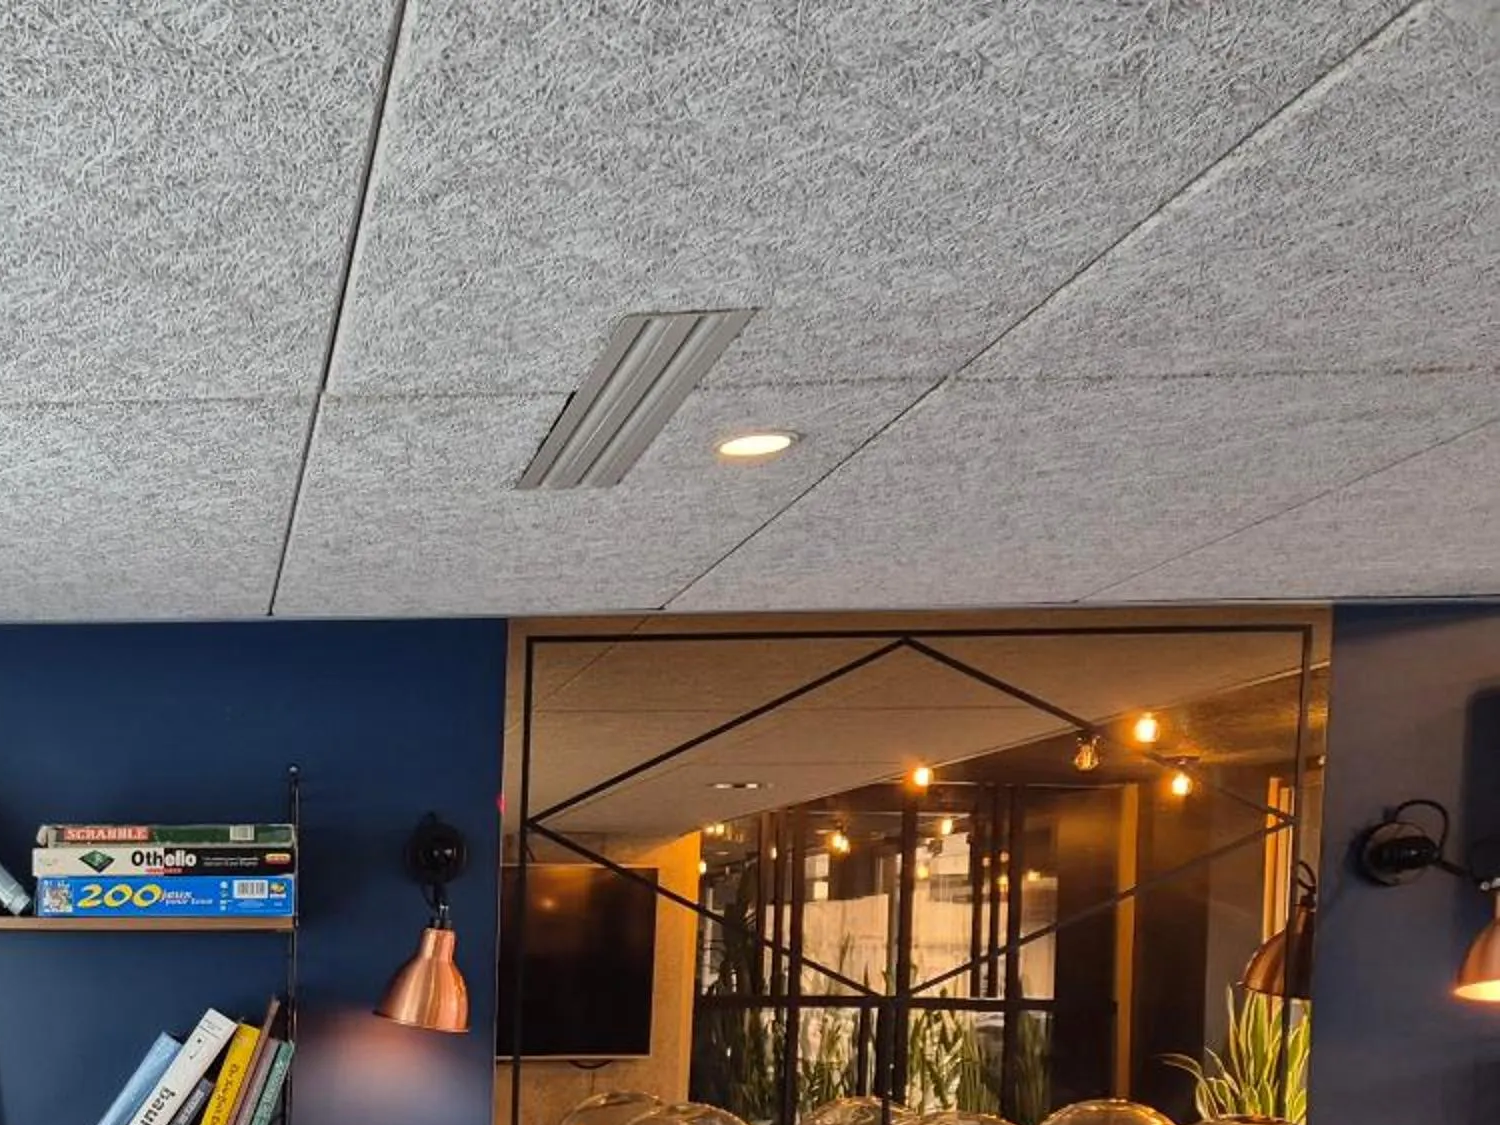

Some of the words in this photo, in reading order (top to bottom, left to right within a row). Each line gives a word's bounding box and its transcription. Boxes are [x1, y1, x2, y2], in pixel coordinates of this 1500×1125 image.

[65, 828, 148, 840] SCRABBLE
[131, 850, 197, 867] Othello
[77, 884, 162, 907] 200
